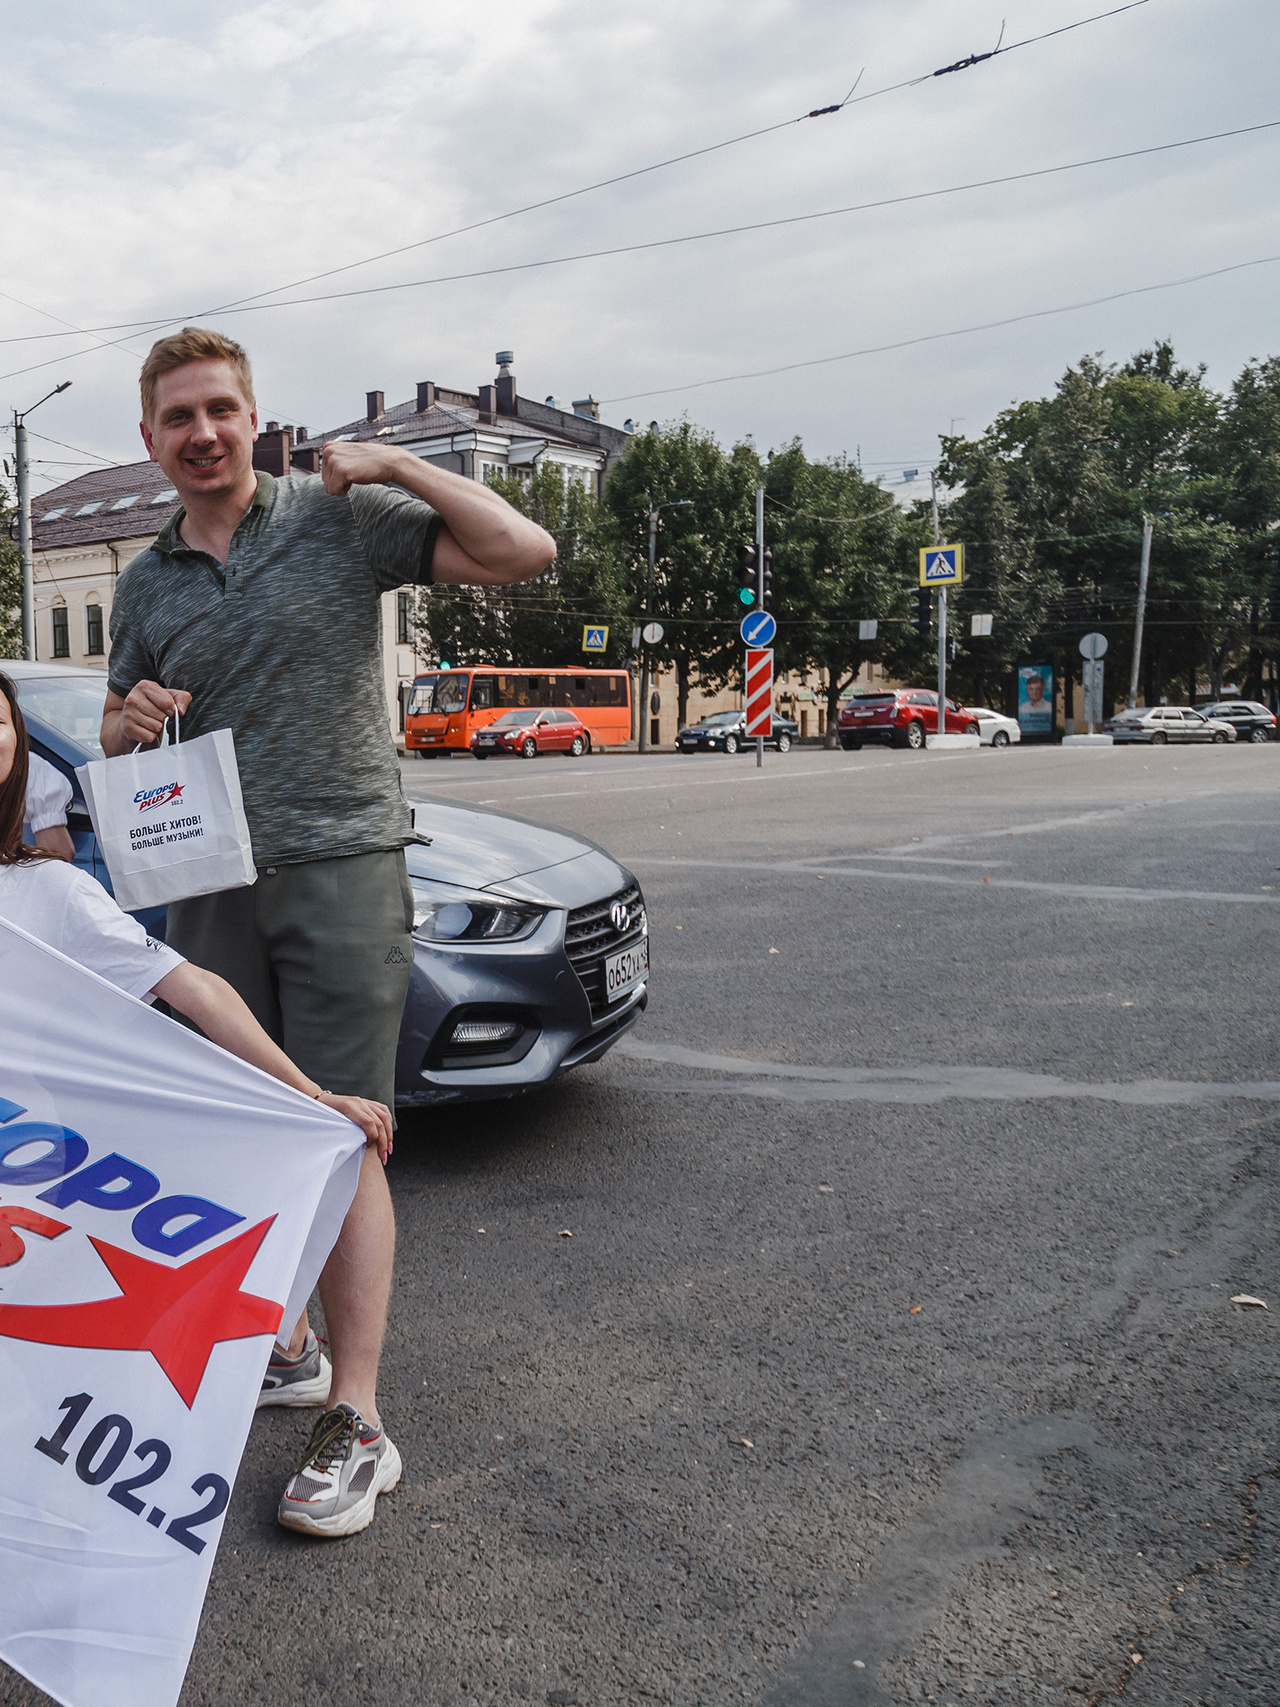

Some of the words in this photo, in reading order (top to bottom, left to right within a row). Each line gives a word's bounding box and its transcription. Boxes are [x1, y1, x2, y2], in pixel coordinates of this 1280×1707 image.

[133, 782, 175, 803] Europa
[130, 822, 167, 839] БОЛЬШЕ
[169, 815, 201, 830] ХИТОВ!
[131, 836, 164, 851] БОЛЬШЕ
[166, 828, 204, 843] МУЗЫКИ!
[34, 1392, 230, 1555] 102.2
